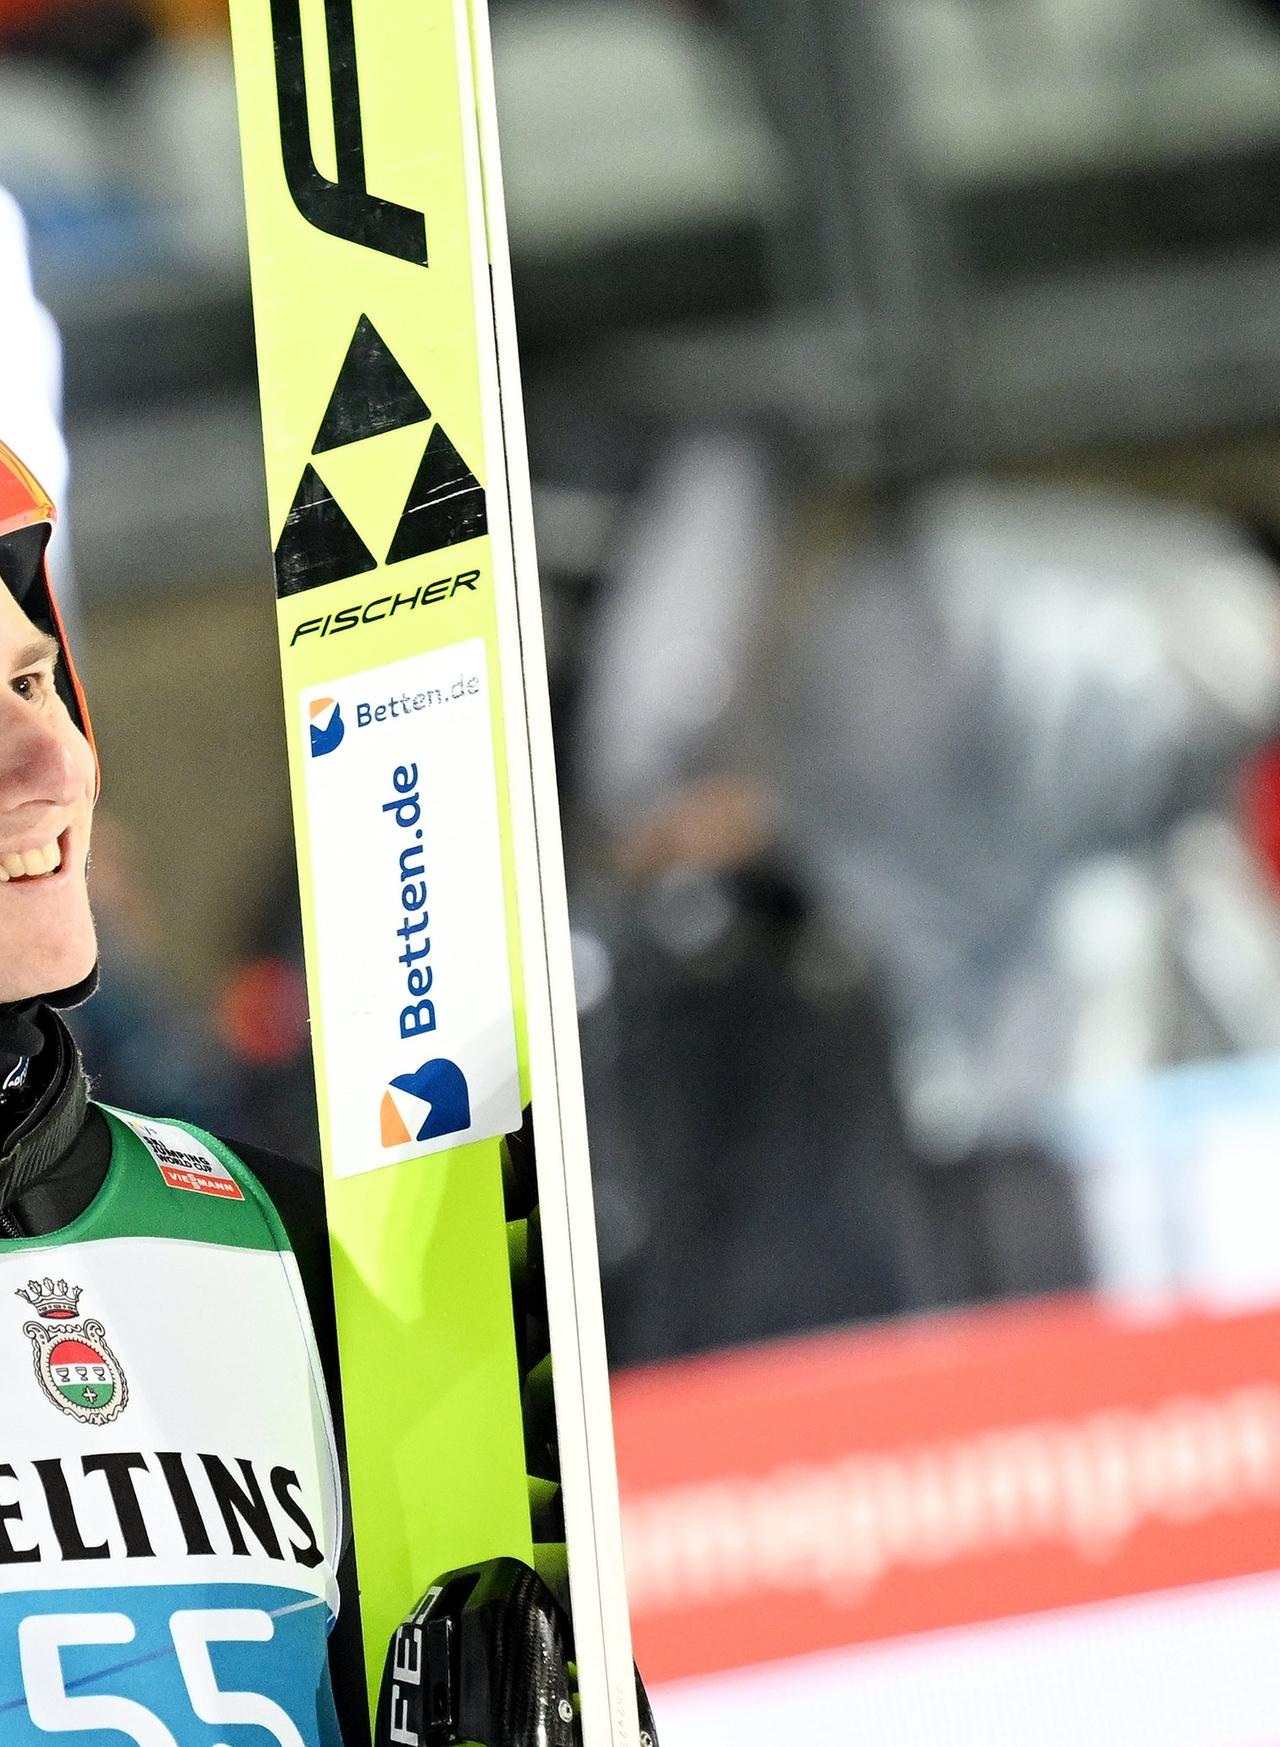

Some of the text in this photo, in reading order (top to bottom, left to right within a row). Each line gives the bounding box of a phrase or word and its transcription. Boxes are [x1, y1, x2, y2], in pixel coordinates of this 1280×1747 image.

[290, 569, 481, 647] FISCHER
[356, 673, 480, 728] Betten.de
[381, 762, 437, 1040] Betten.de
[150, 1143, 210, 1166] JUMPING
[156, 1153, 213, 1173] WORLD CUP
[167, 1171, 234, 1192] VIESSMANN
[18, 1608, 306, 1747] 55
